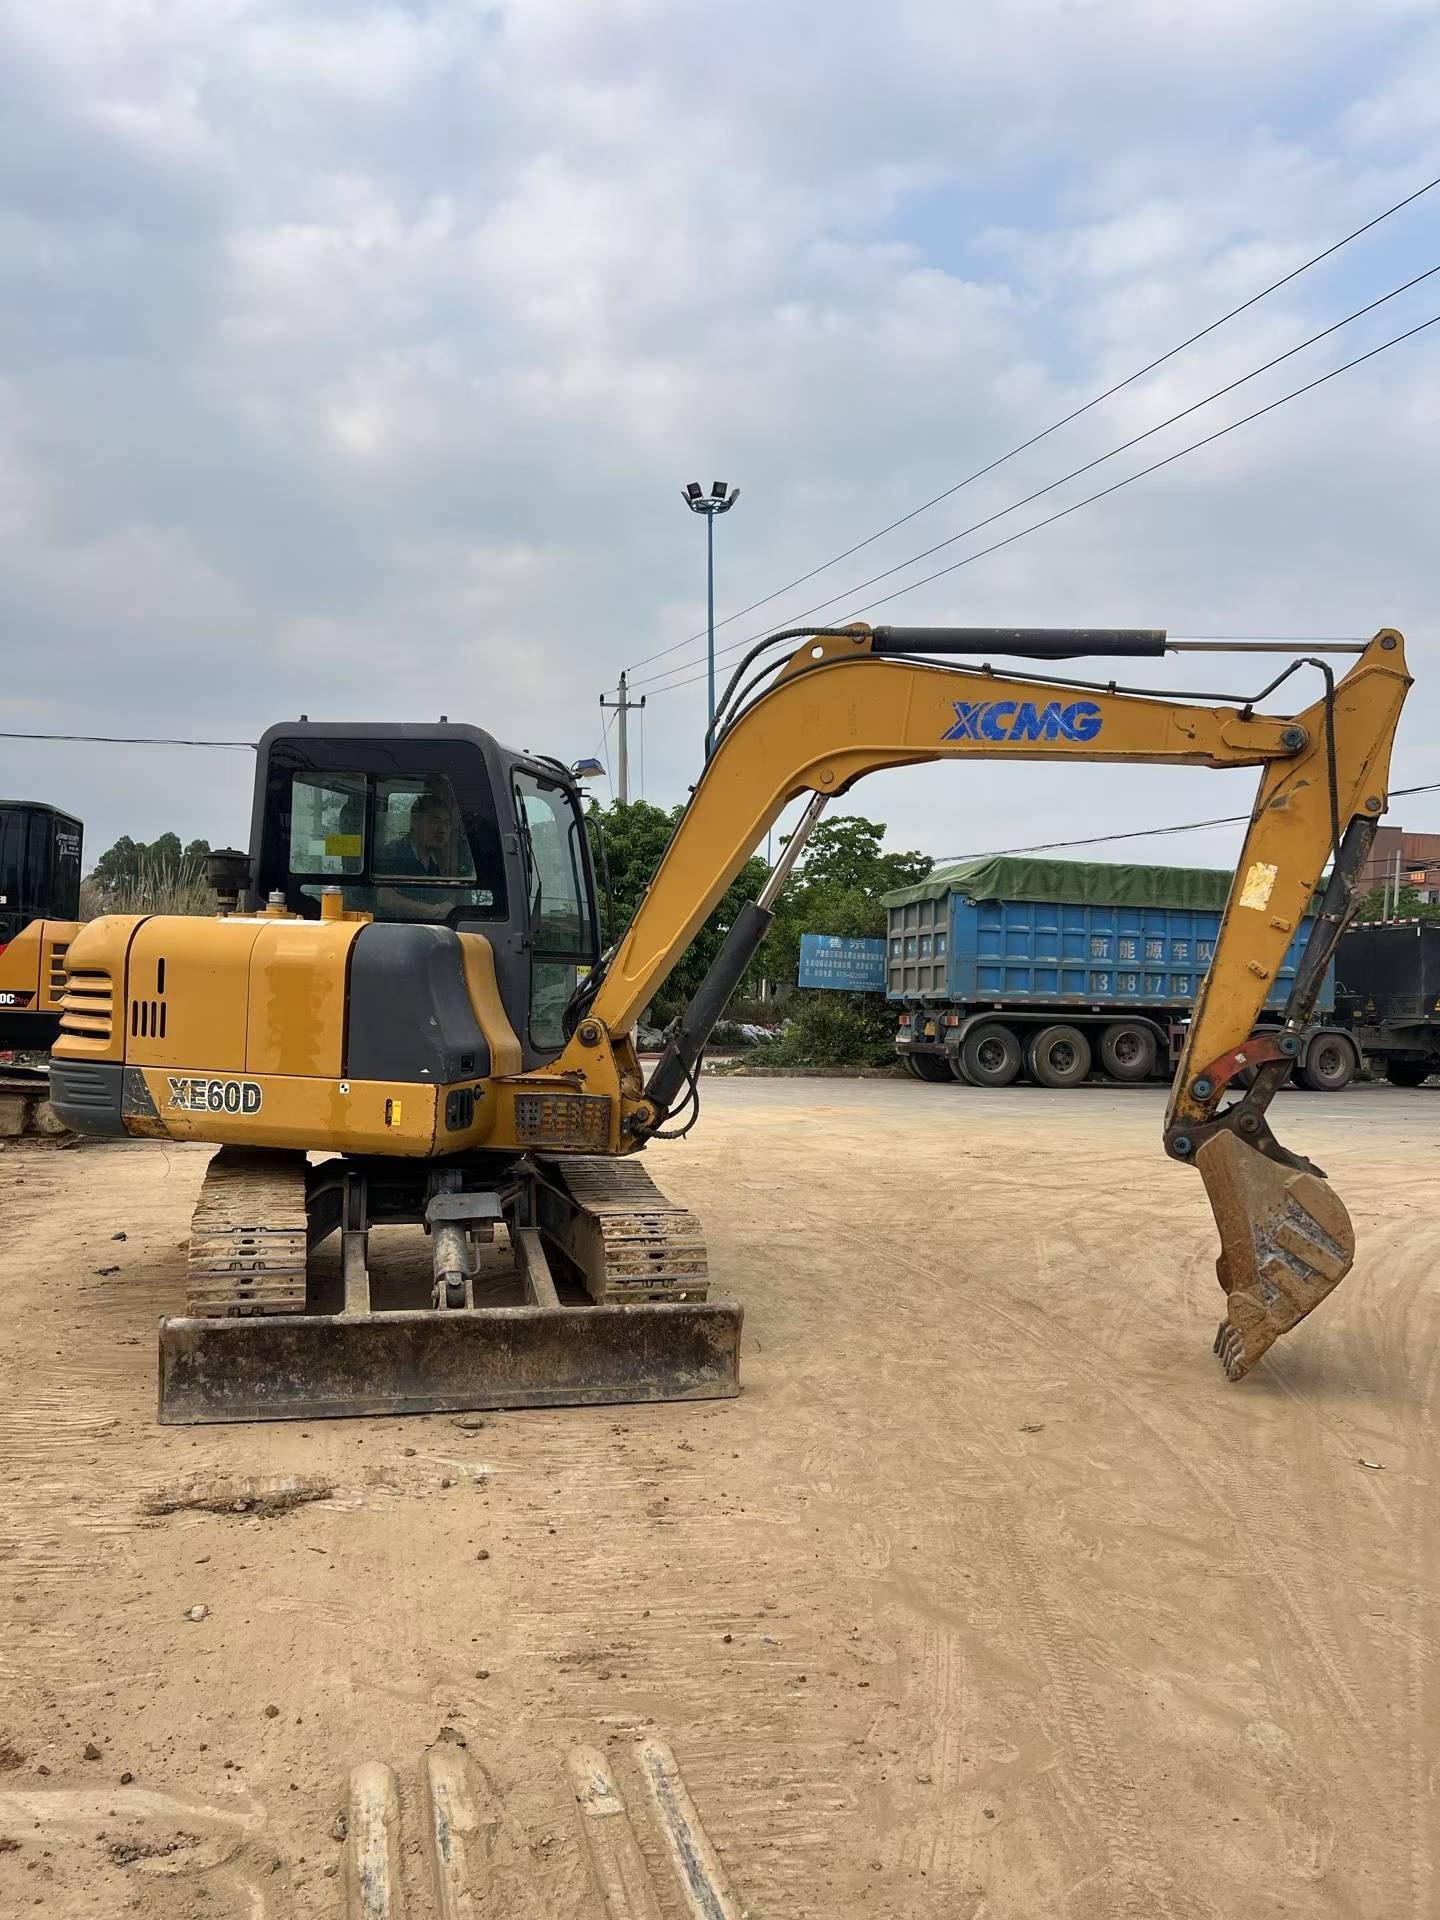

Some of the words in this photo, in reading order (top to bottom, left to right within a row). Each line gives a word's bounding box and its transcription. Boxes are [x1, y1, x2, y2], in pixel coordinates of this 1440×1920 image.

[940, 701, 1103, 741] XCMG
[1090, 938, 1213, 960] 新能源车队
[167, 1077, 262, 1115] XE60D
